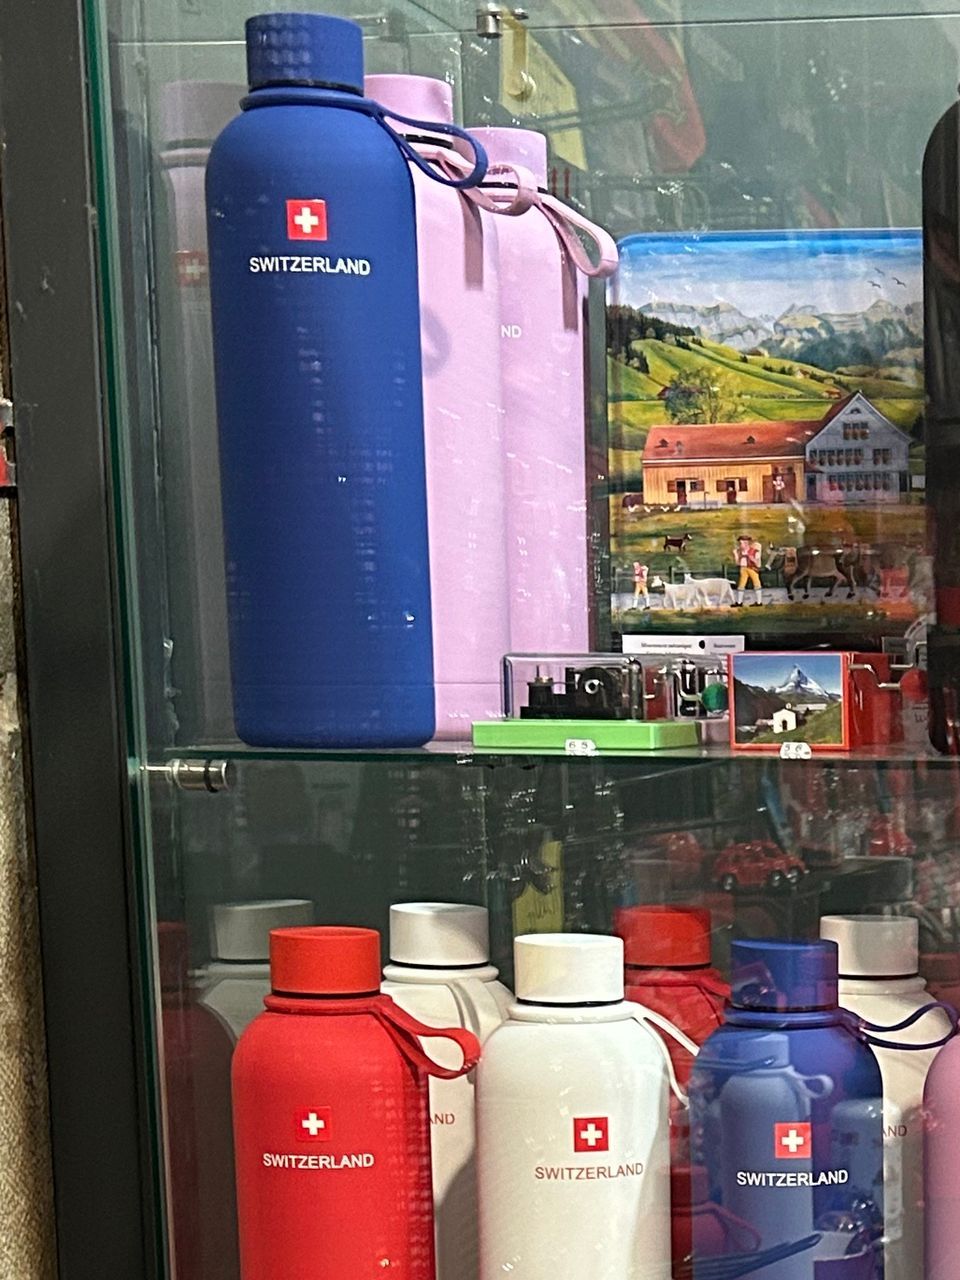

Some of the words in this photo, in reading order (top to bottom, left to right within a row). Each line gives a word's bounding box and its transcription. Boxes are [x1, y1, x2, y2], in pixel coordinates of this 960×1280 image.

[249, 255, 370, 276] SWITZERLAND
[262, 1152, 374, 1169] SWITZERLAND
[535, 1162, 644, 1180] SWITZERLAND
[736, 1169, 848, 1188] SWITZERLAND
